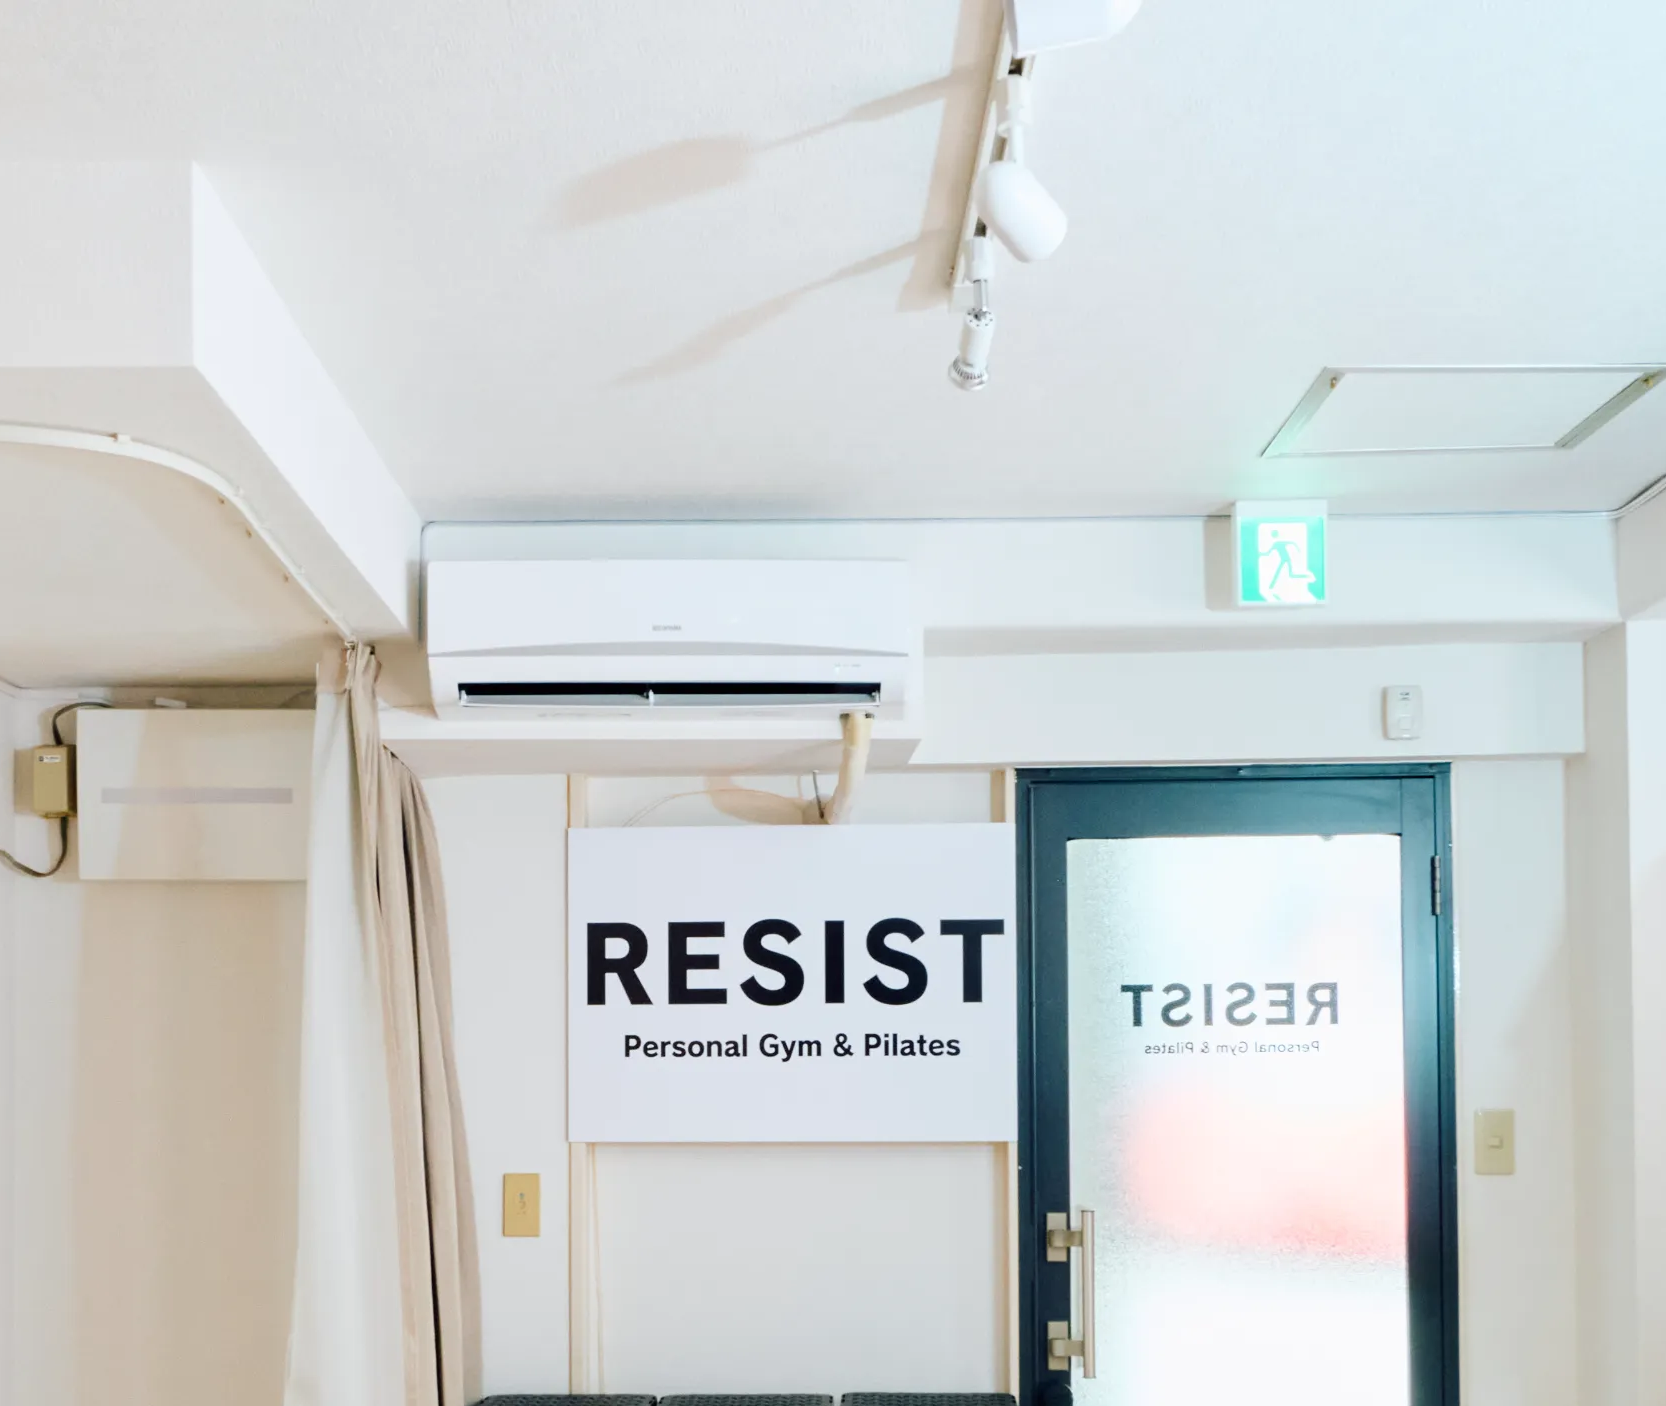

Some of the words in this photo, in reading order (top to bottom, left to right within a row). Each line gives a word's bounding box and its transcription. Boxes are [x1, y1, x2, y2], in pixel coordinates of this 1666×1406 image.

[586, 917, 1005, 1007] RESIST
[624, 1033, 748, 1058] Personal
[759, 1033, 822, 1063] Gym
[833, 1032, 854, 1057] &
[864, 1033, 961, 1057] Pilates
